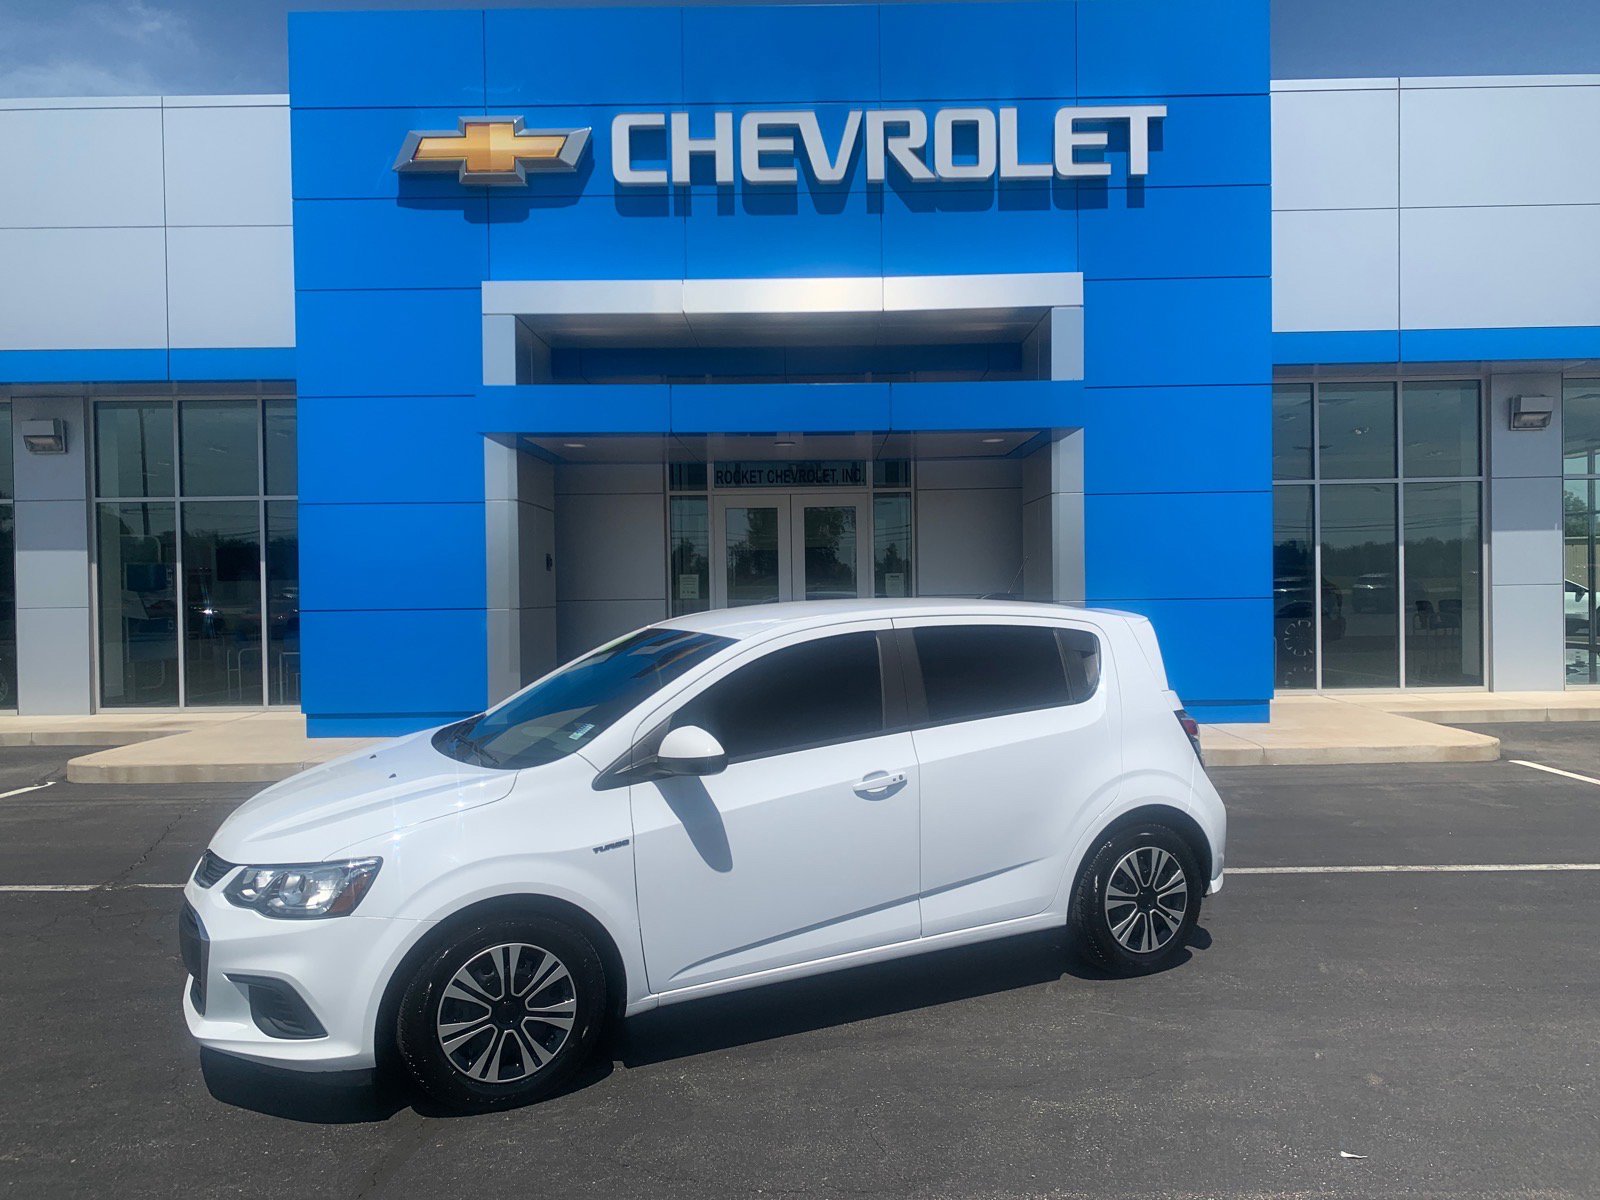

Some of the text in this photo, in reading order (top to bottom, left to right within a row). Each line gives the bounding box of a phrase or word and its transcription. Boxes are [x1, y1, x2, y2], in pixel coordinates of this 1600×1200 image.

[611, 105, 1168, 186] CHEVROLET
[716, 467, 865, 485] ROCKET CHEVROLET, INC.
